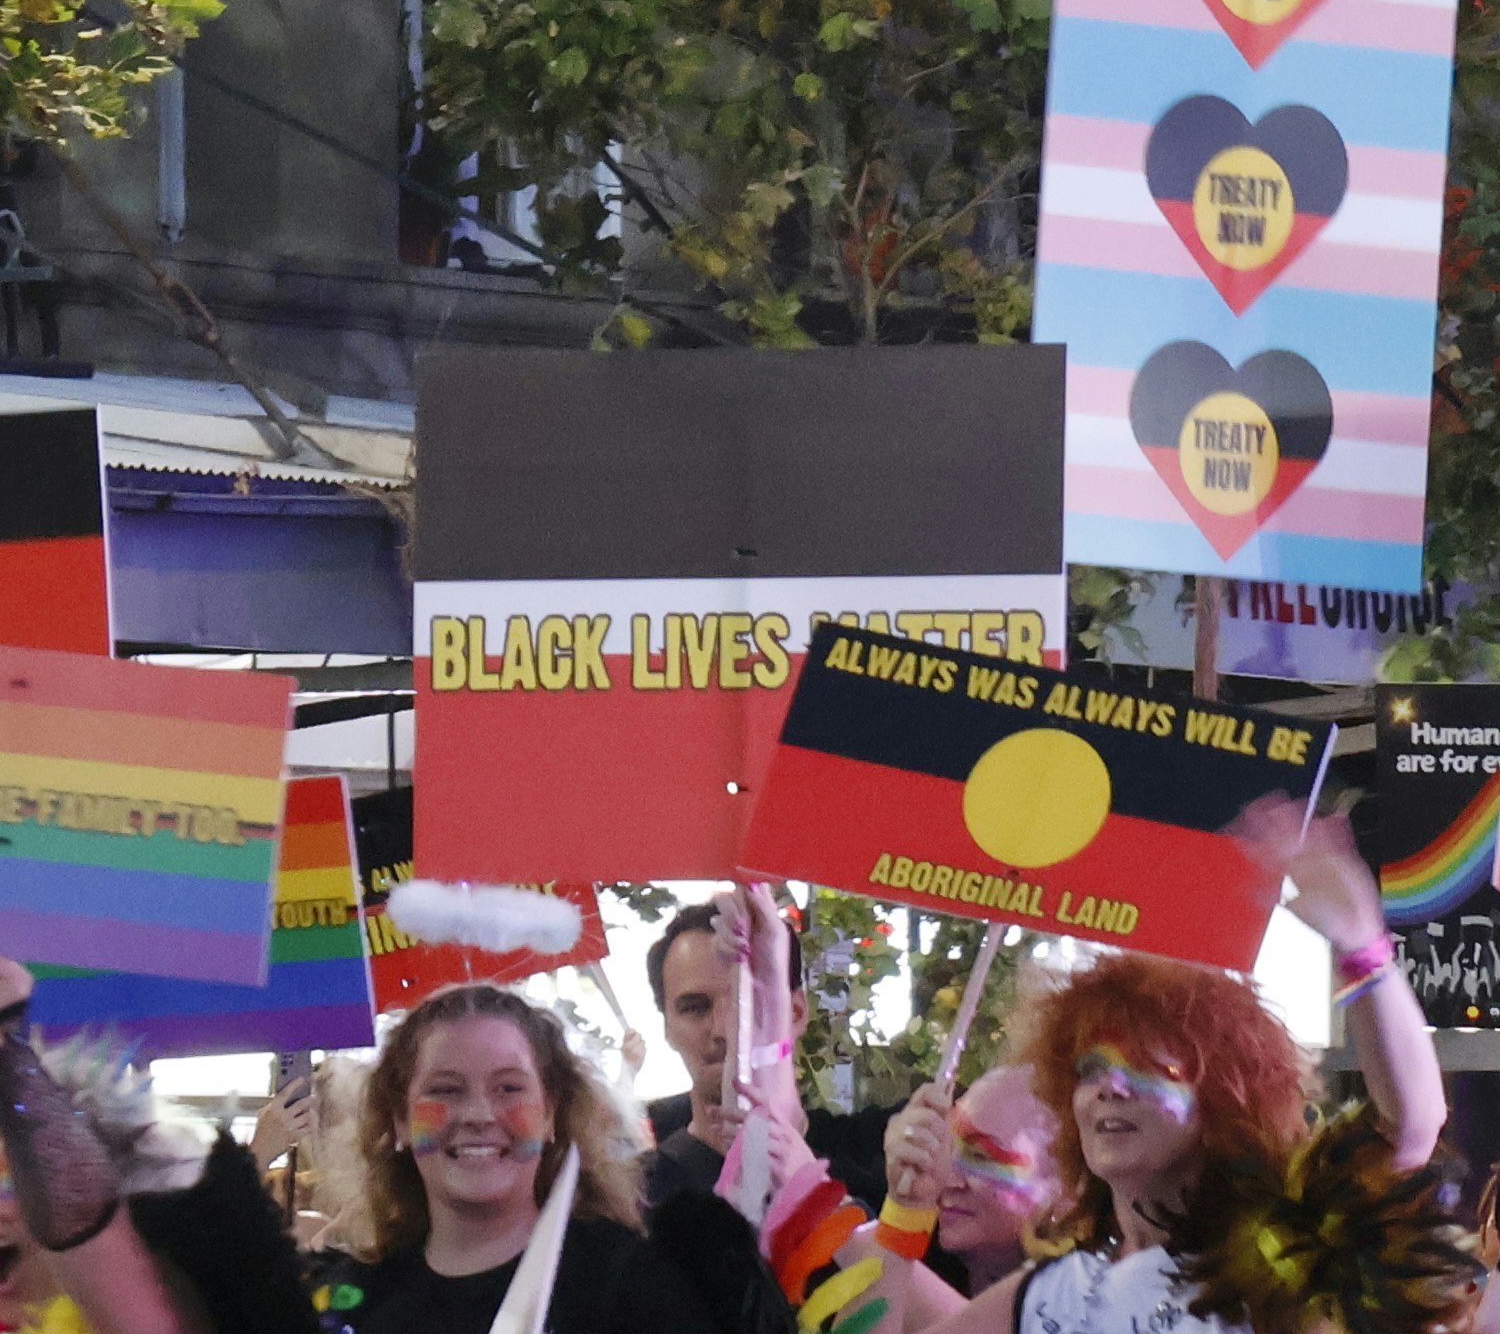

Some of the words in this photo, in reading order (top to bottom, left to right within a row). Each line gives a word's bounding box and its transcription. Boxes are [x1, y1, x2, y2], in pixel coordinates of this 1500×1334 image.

[1210, 171, 1283, 211] TREATY
[1217, 210, 1266, 247] NOW
[1193, 420, 1266, 458] TREATY
[1203, 456, 1251, 493] NOW
[430, 615, 610, 692] BLACK
[631, 614, 789, 689] LIVES
[825, 637, 958, 693] ALWAYS
[967, 665, 1039, 709] WAS
[1044, 682, 1174, 740] ALWAYS
[1184, 708, 1256, 756] WILL
[1266, 726, 1312, 766] BE
[1396, 754, 1434, 773] are
[1439, 751, 1478, 773] for
[272, 898, 347, 930] OUTH
[870, 854, 1044, 919] ABORIGINAL
[1057, 889, 1139, 937] LAND
